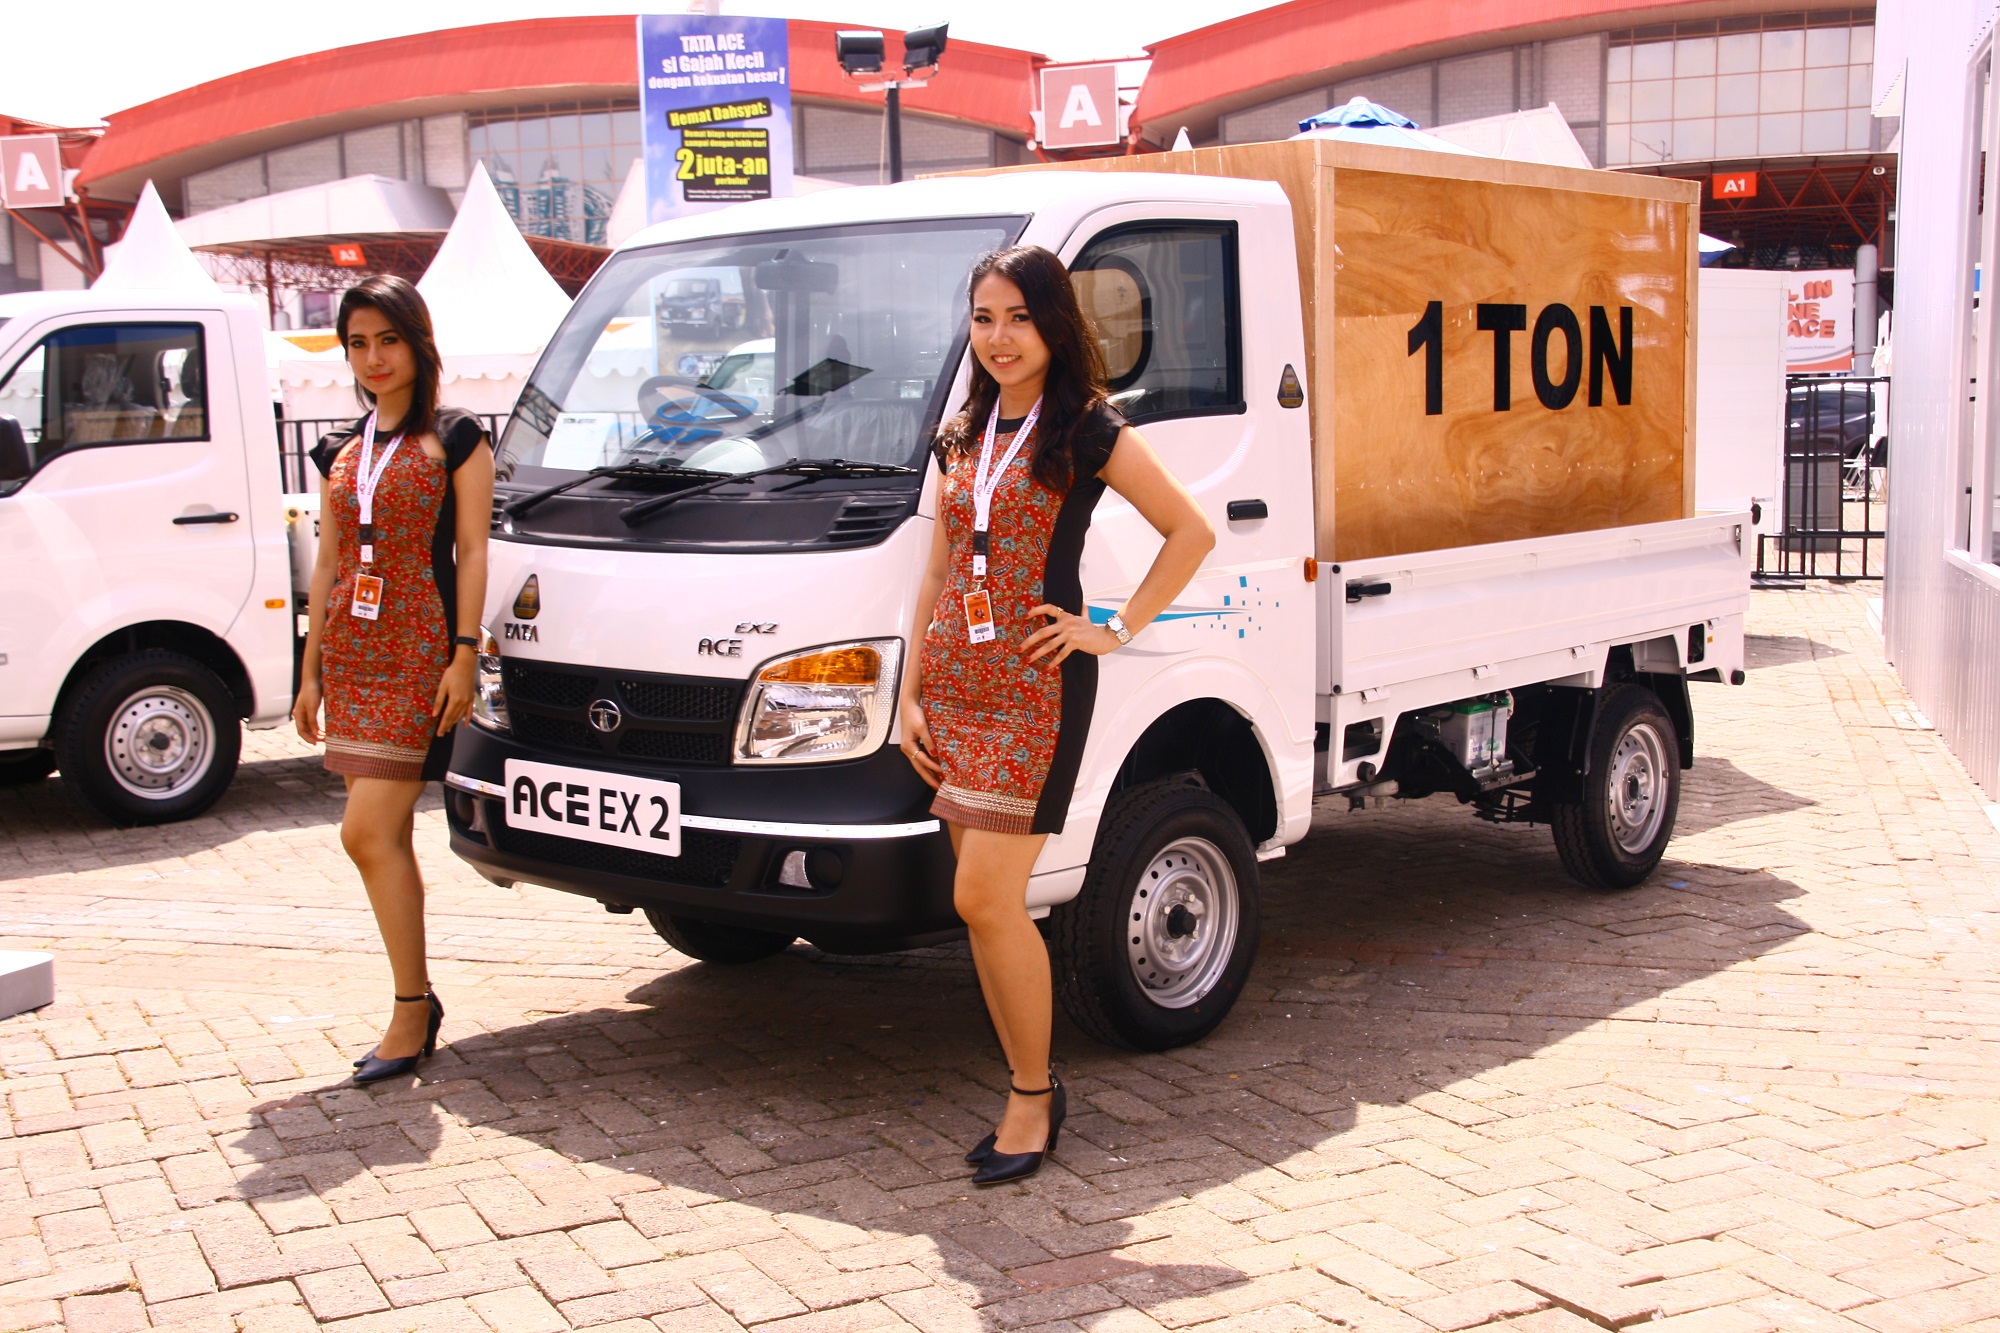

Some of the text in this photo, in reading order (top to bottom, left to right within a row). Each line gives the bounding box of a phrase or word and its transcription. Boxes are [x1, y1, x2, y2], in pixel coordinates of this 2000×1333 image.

[680, 33, 745, 53] TATA ACE
[662, 52, 764, 73] si Gajah Kecil
[648, 76, 691, 89] dengan
[693, 72, 745, 87] kekuatan
[670, 102, 767, 127] Hemat Dahsyat:
[1059, 84, 1102, 128] A
[15, 152, 50, 192] A
[676, 148, 768, 180] 2 juta-an
[1723, 178, 1746, 193] A1
[340, 249, 359, 261] A2
[1804, 279, 1832, 300] IN
[1788, 303, 1820, 320] NE
[1788, 319, 1835, 338] ACE
[1407, 300, 1633, 416] 1 TON
[985, 461, 1006, 495] INDONESIA
[1004, 417, 1033, 461] INTERNATIONAL
[504, 623, 539, 642] TATA
[735, 621, 779, 634] EX2
[698, 637, 743, 657] ACE
[513, 776, 590, 827] ACE
